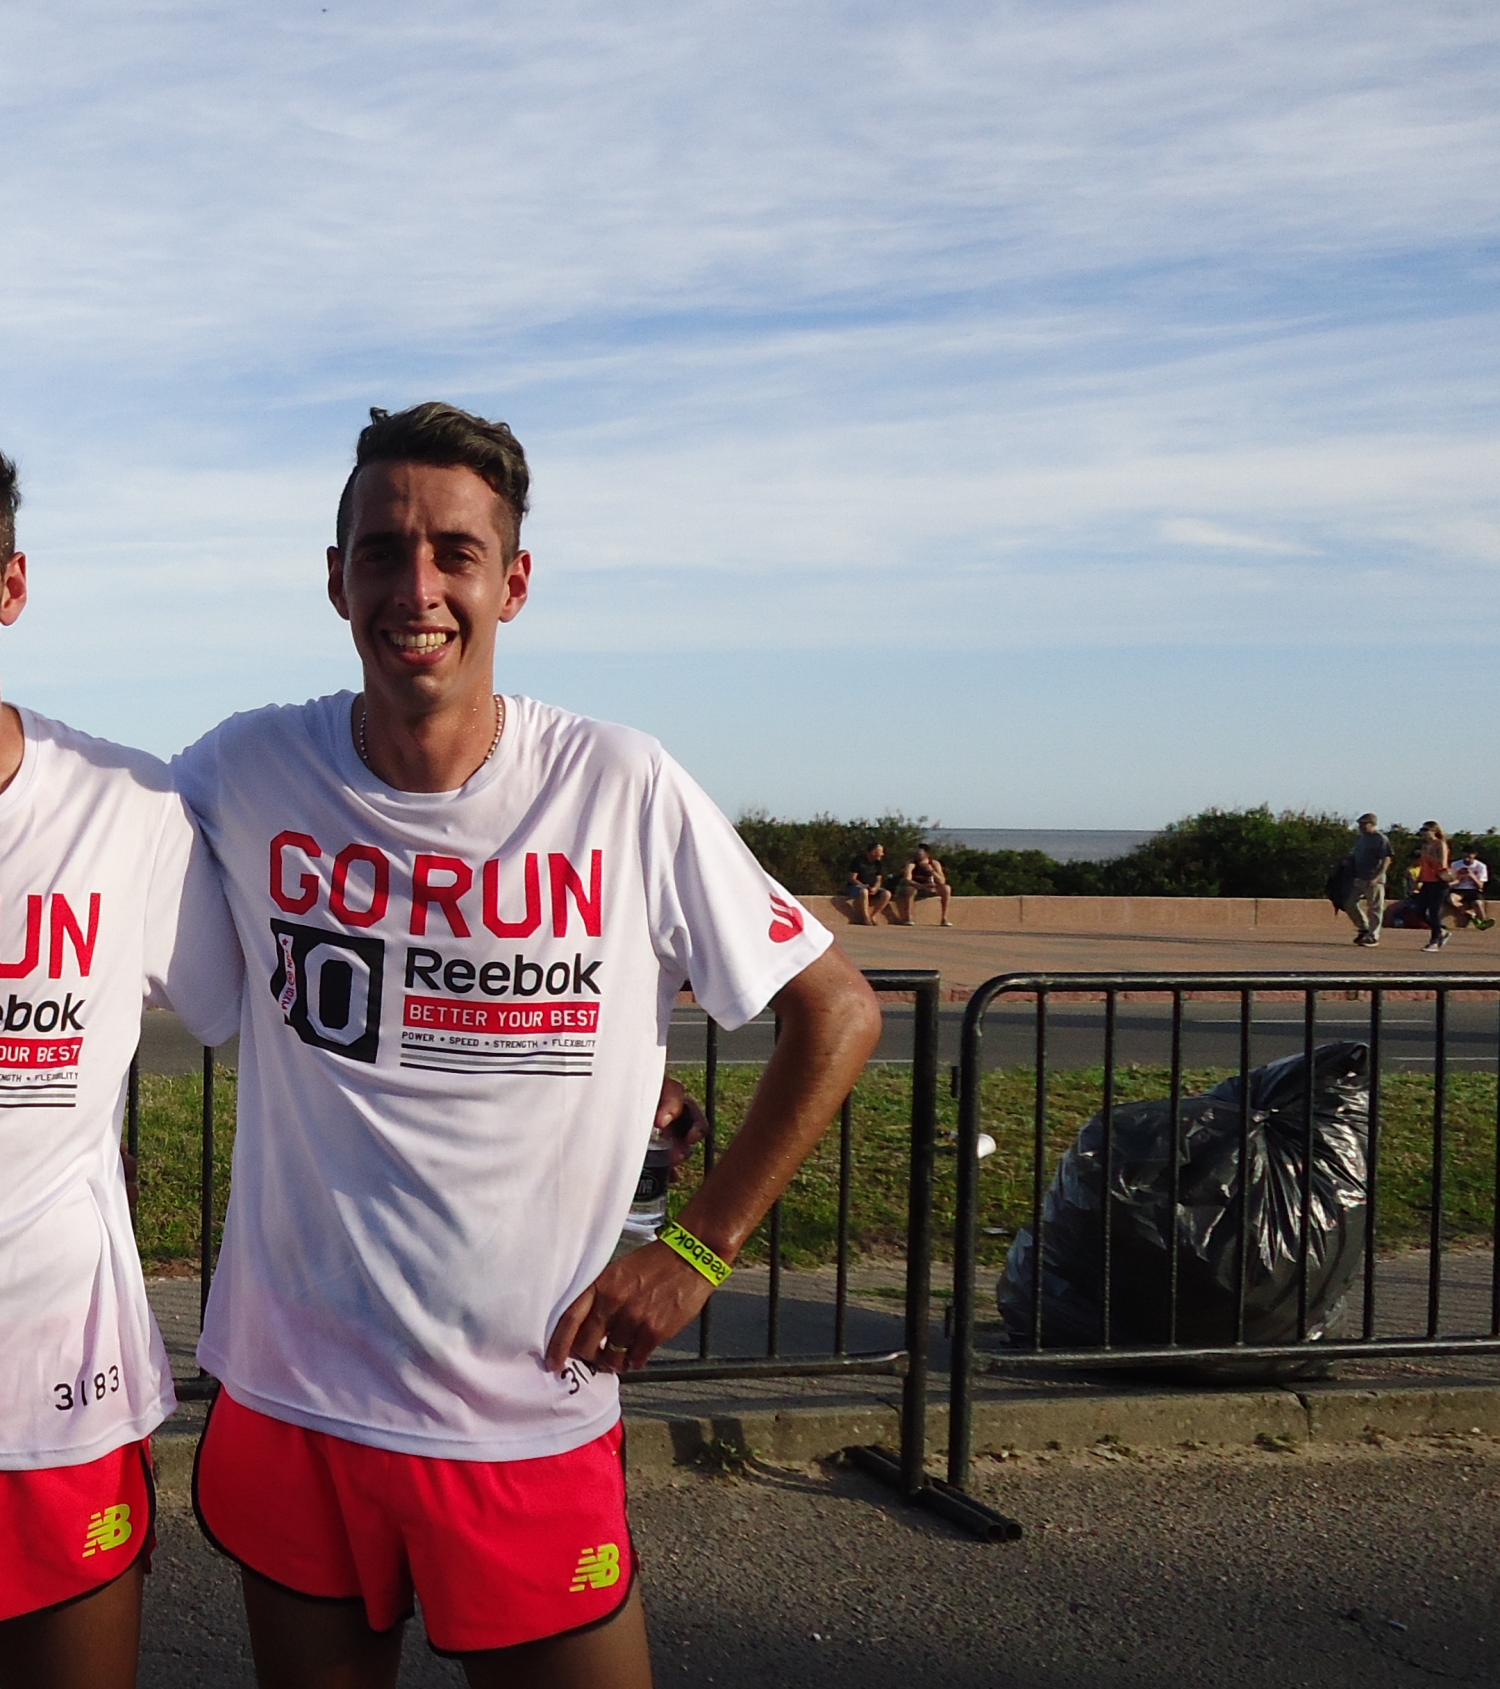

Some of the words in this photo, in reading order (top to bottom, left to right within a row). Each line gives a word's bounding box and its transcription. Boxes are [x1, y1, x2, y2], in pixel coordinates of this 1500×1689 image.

[270, 830, 390, 928] GO
[409, 849, 603, 939] RUN
[404, 946, 604, 996] Reebok
[401, 1031, 435, 1042] POWER
[449, 1036, 479, 1047] SPEED
[493, 1040, 538, 1048] STRENGTH
[409, 1005, 487, 1027] BETTER
[498, 1010, 543, 1029] YOUR
[550, 1009, 597, 1027] BEST
[36, 1045, 80, 1062] BEST
[674, 1230, 727, 1281] Reebok
[53, 1365, 120, 1411] 3183
